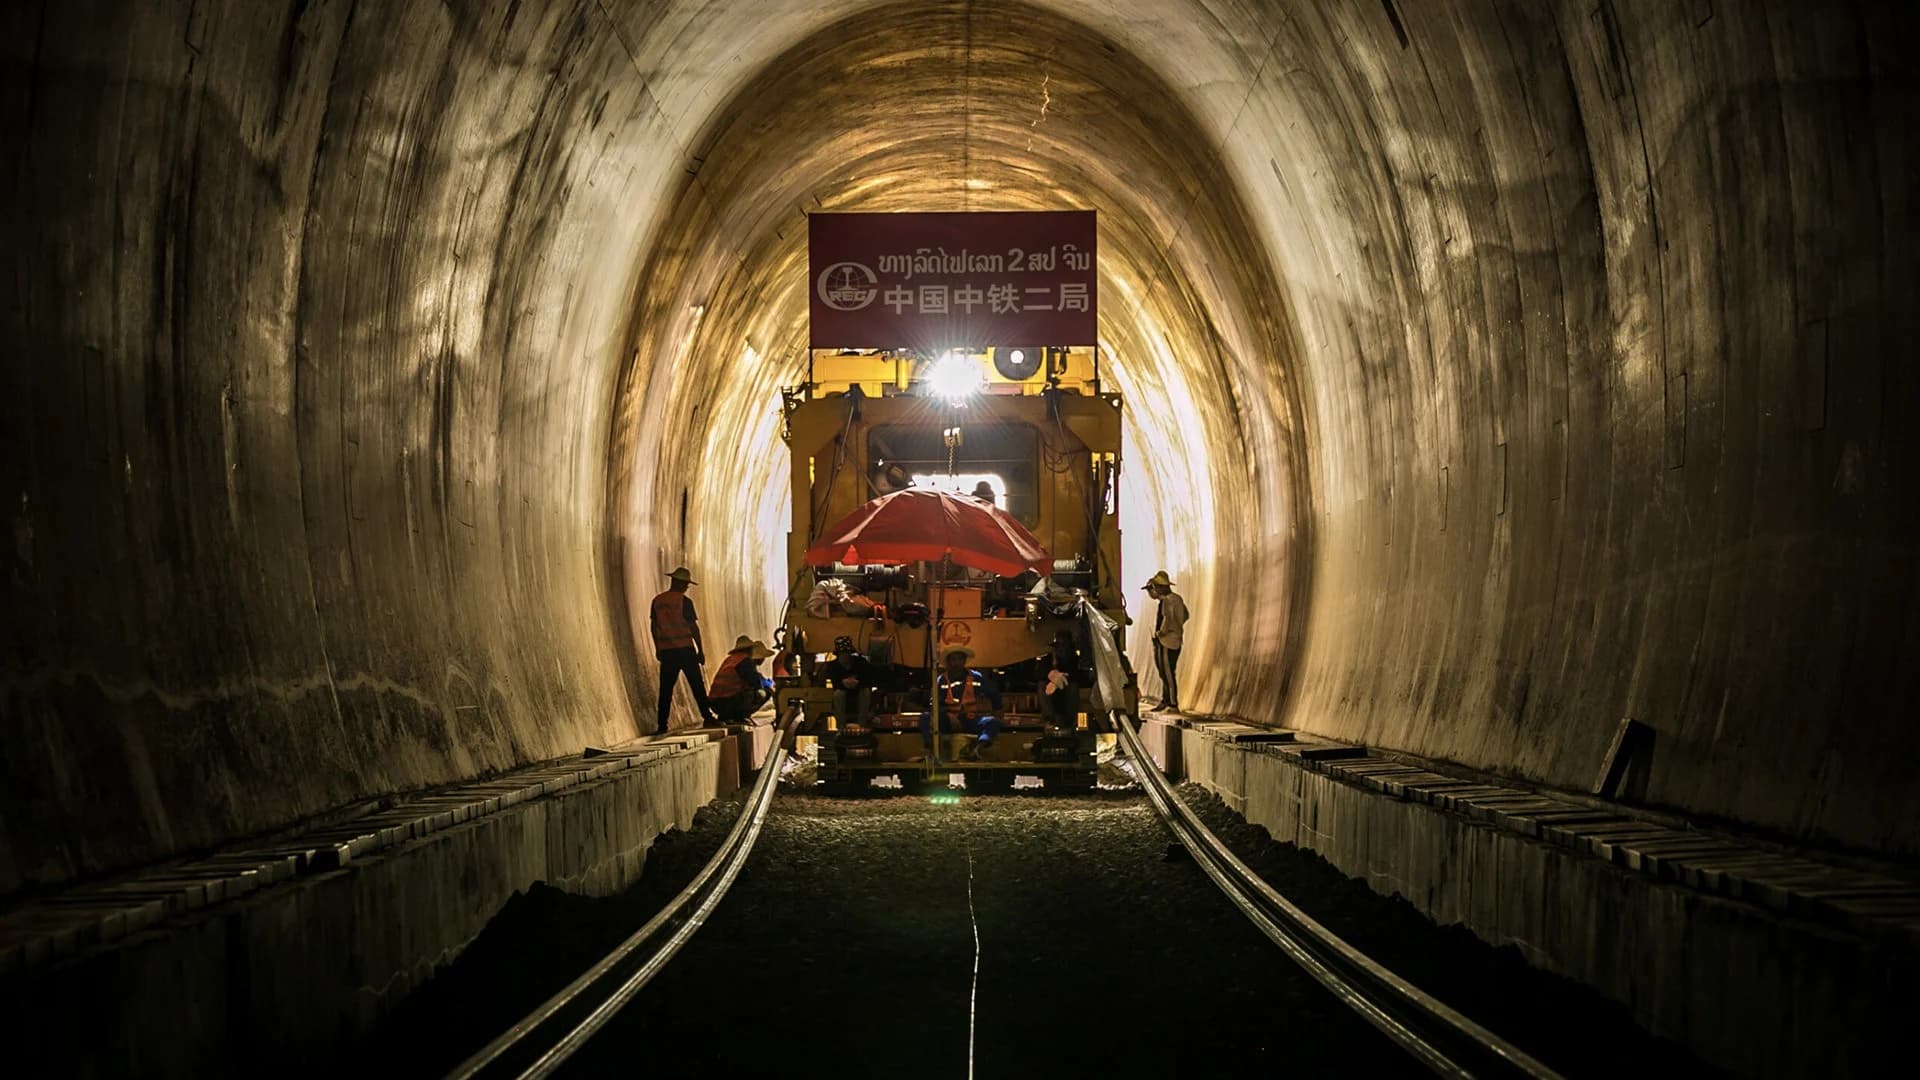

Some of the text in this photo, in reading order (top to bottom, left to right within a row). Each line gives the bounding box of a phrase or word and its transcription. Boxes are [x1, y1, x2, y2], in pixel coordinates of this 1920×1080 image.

[1007, 248, 1025, 272] 2
[884, 283, 1090, 315] 中国中铁二局
